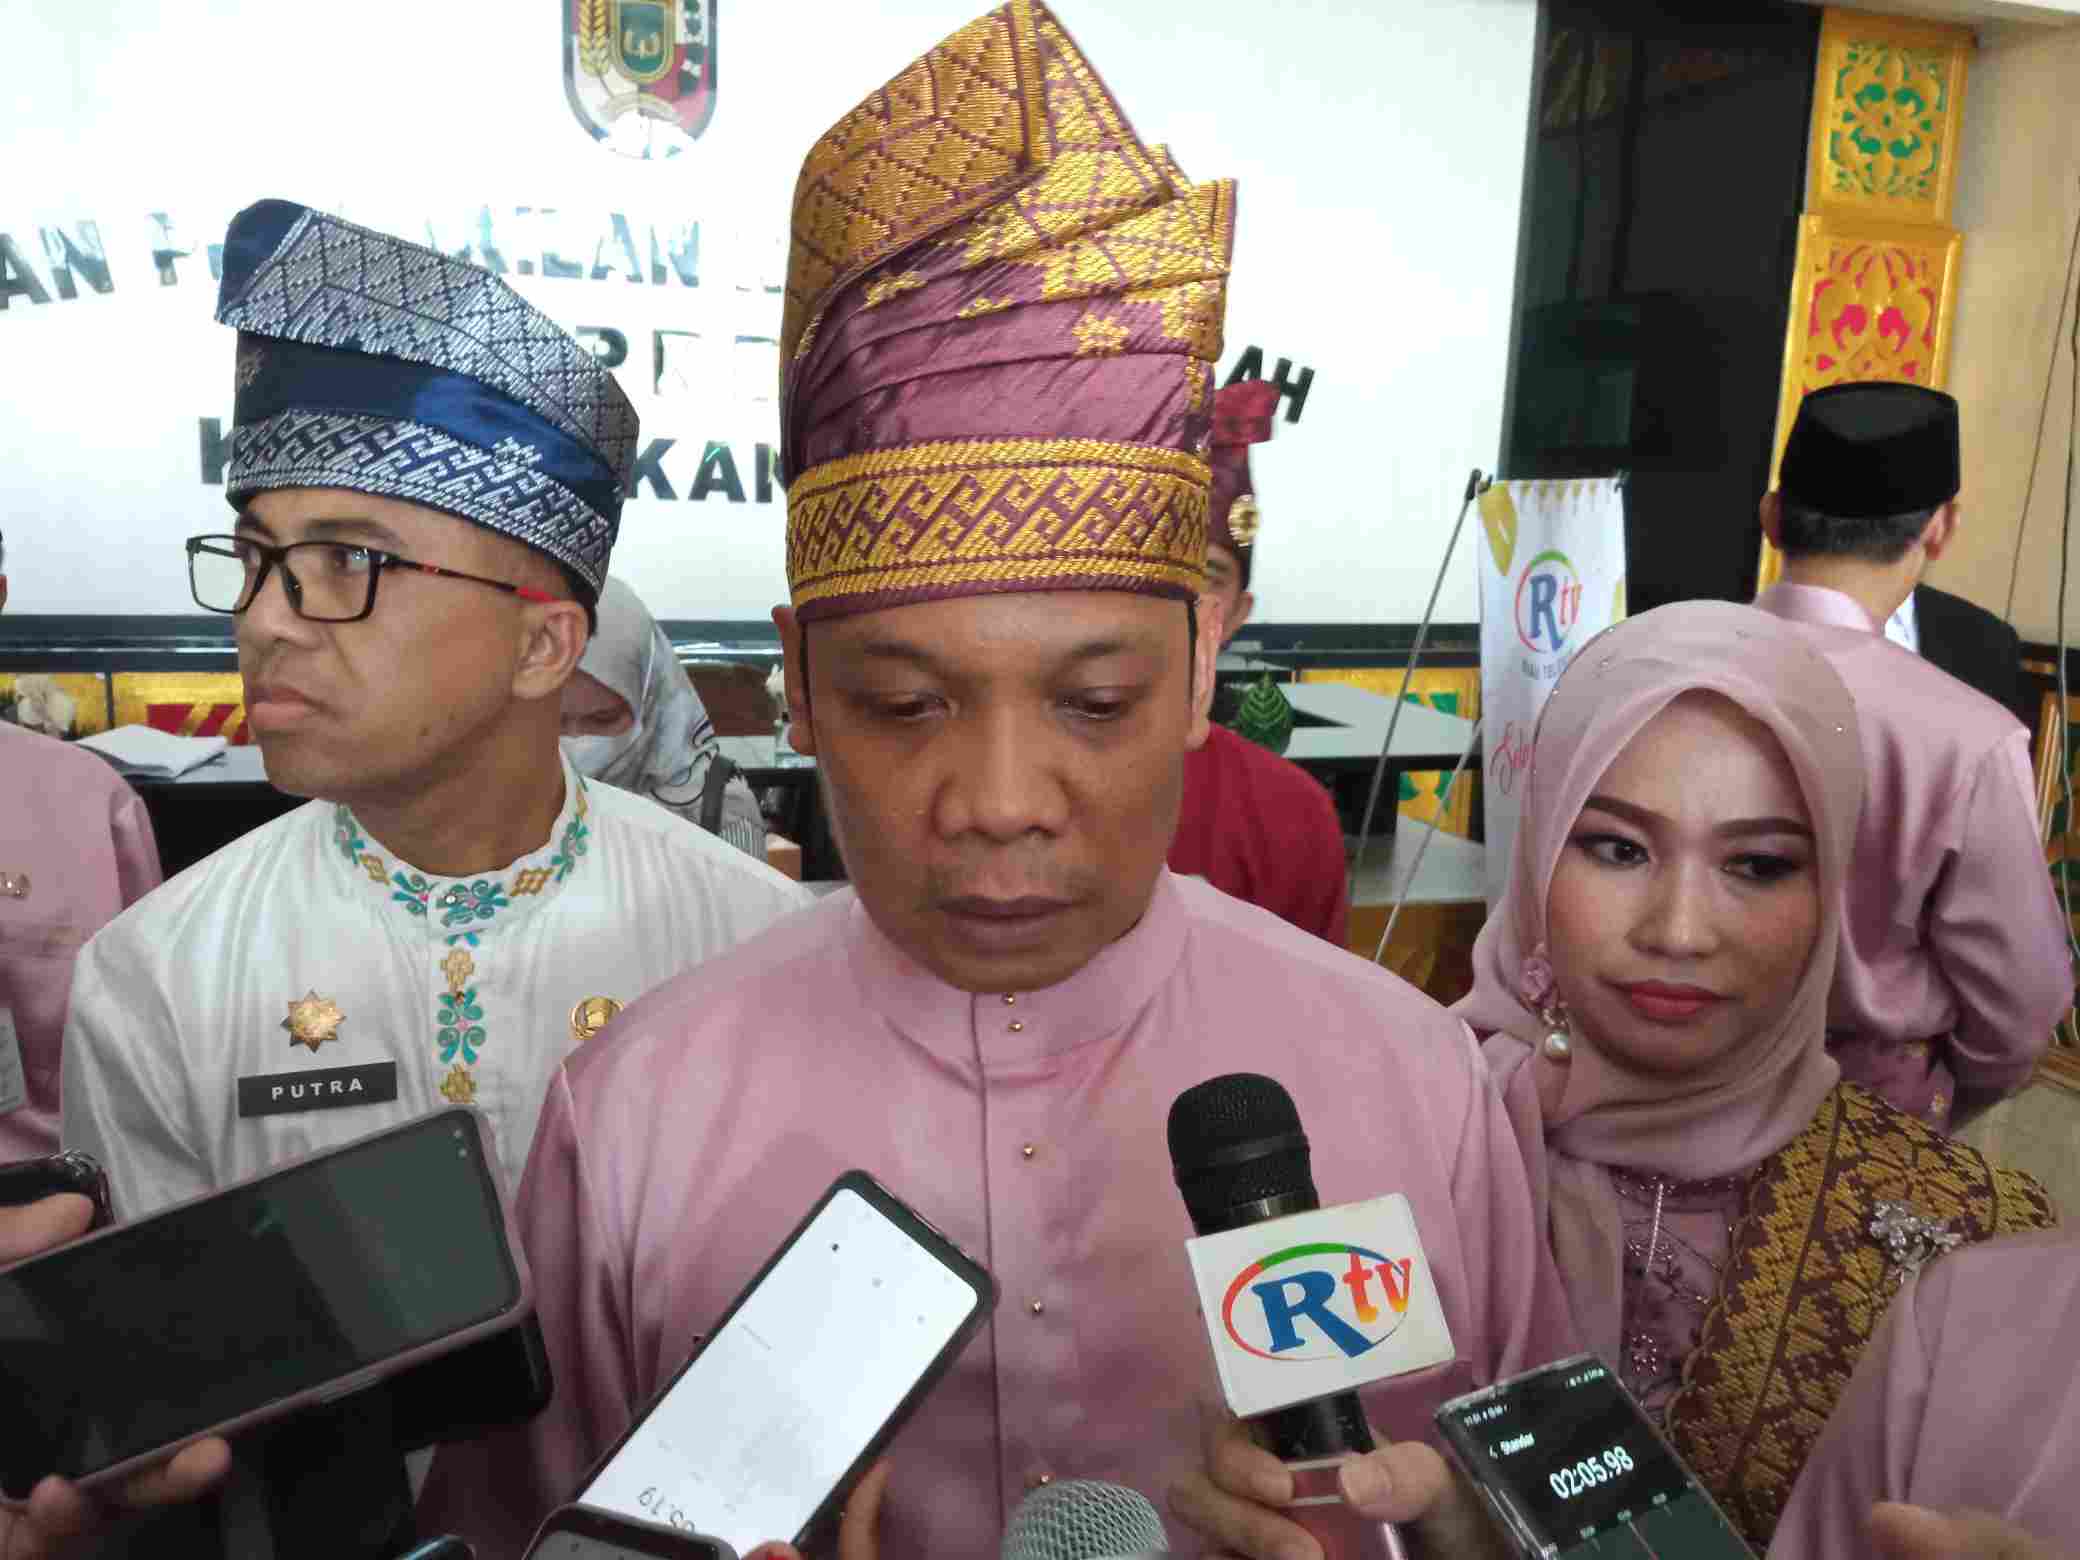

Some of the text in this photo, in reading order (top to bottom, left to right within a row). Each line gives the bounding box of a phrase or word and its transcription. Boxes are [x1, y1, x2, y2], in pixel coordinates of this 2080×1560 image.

[271, 1077, 364, 1101] PUTRA
[1251, 1251, 1415, 1358] Rtv
[1549, 1445, 1634, 1500] 02:05.98
